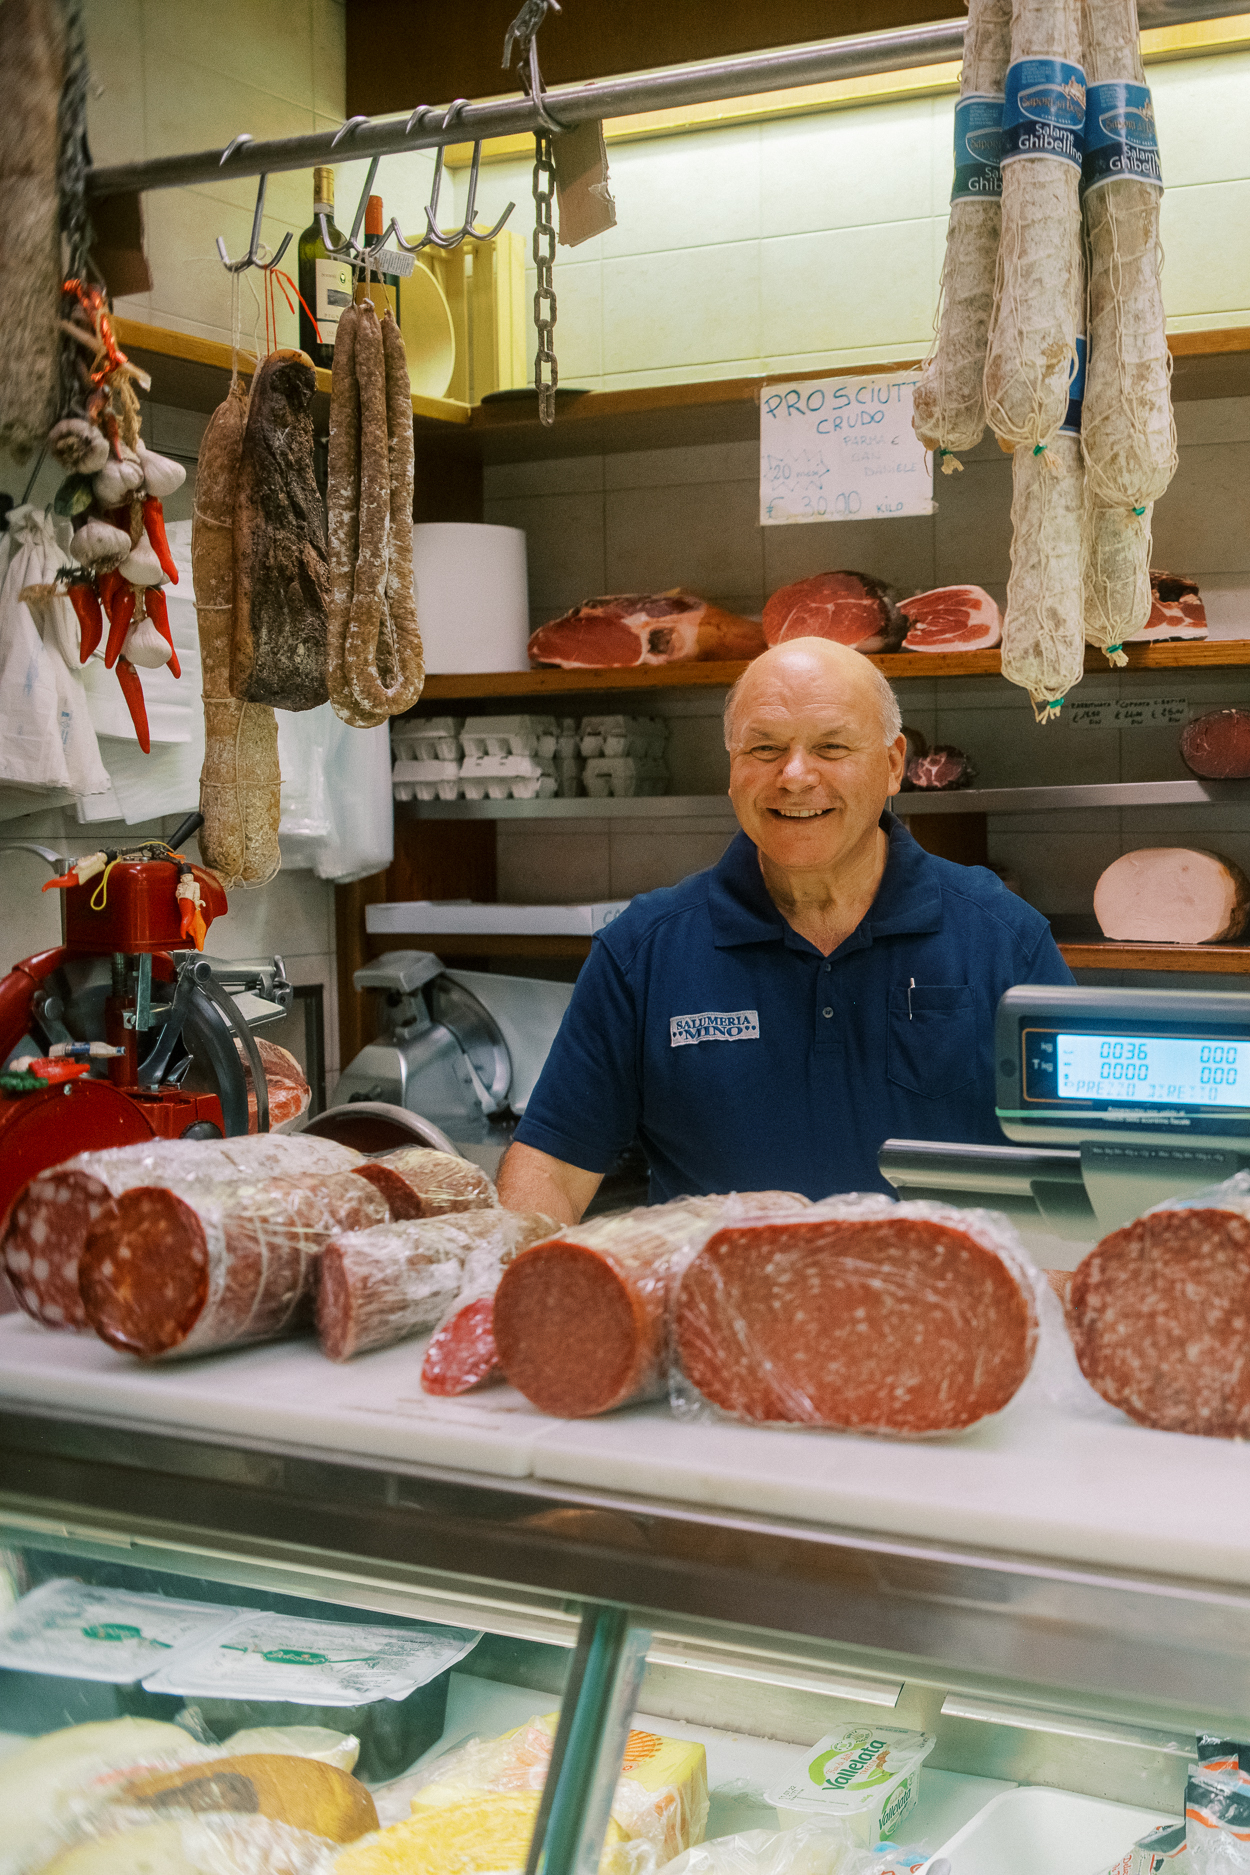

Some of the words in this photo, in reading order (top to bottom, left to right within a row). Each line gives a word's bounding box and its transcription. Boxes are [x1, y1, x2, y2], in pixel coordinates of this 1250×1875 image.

[1035, 123, 1075, 144] Salame
[1018, 134, 1083, 164] Ghibellino
[1109, 155, 1161, 176] Ghibelli
[816, 410, 884, 434] CRUDO
[771, 464, 792, 482] 20
[676, 1016, 751, 1030] SALUMERIA
[684, 1026, 744, 1040] MINO
[1040, 1042, 1054, 1054] kg
[1100, 1042, 1148, 1060] 0036
[1200, 1046, 1238, 1064] 000
[1032, 1058, 1040, 1070] T
[1041, 1061, 1054, 1072] kg
[1100, 1062, 1149, 1080] 0000
[1200, 1066, 1238, 1086] 000
[822, 1739, 888, 1790] Vallelata
[878, 1788, 912, 1830] Vallelata
